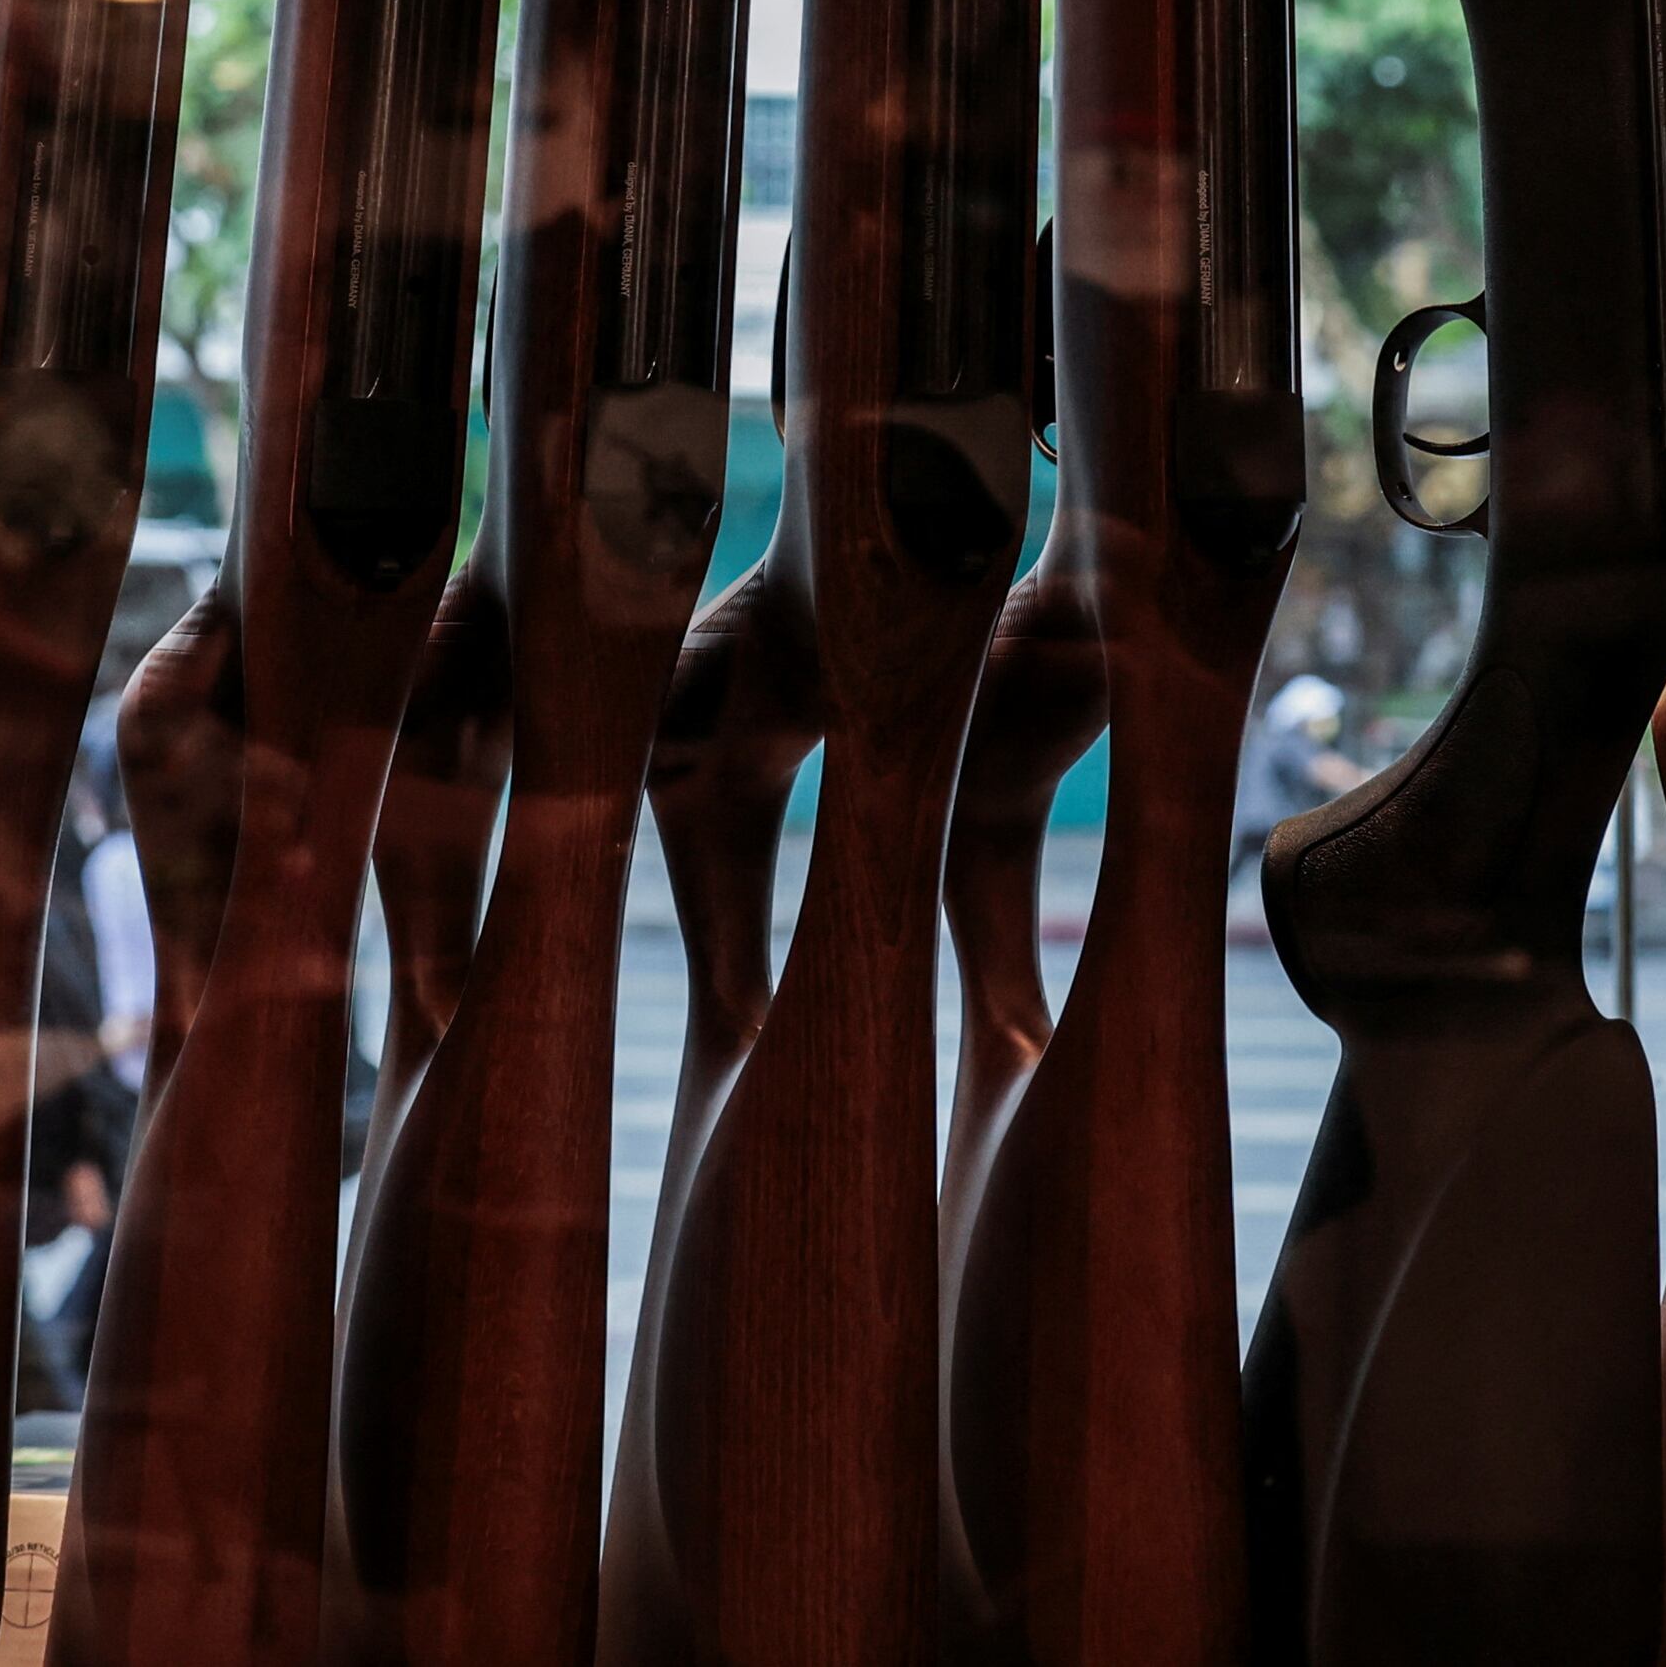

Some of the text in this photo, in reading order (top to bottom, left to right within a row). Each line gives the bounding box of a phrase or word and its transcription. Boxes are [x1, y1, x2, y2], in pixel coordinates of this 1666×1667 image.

[347, 259, 362, 308] GERMANY
[620, 248, 633, 297] GERMANY
[1199, 257, 1212, 305] GERMANY
